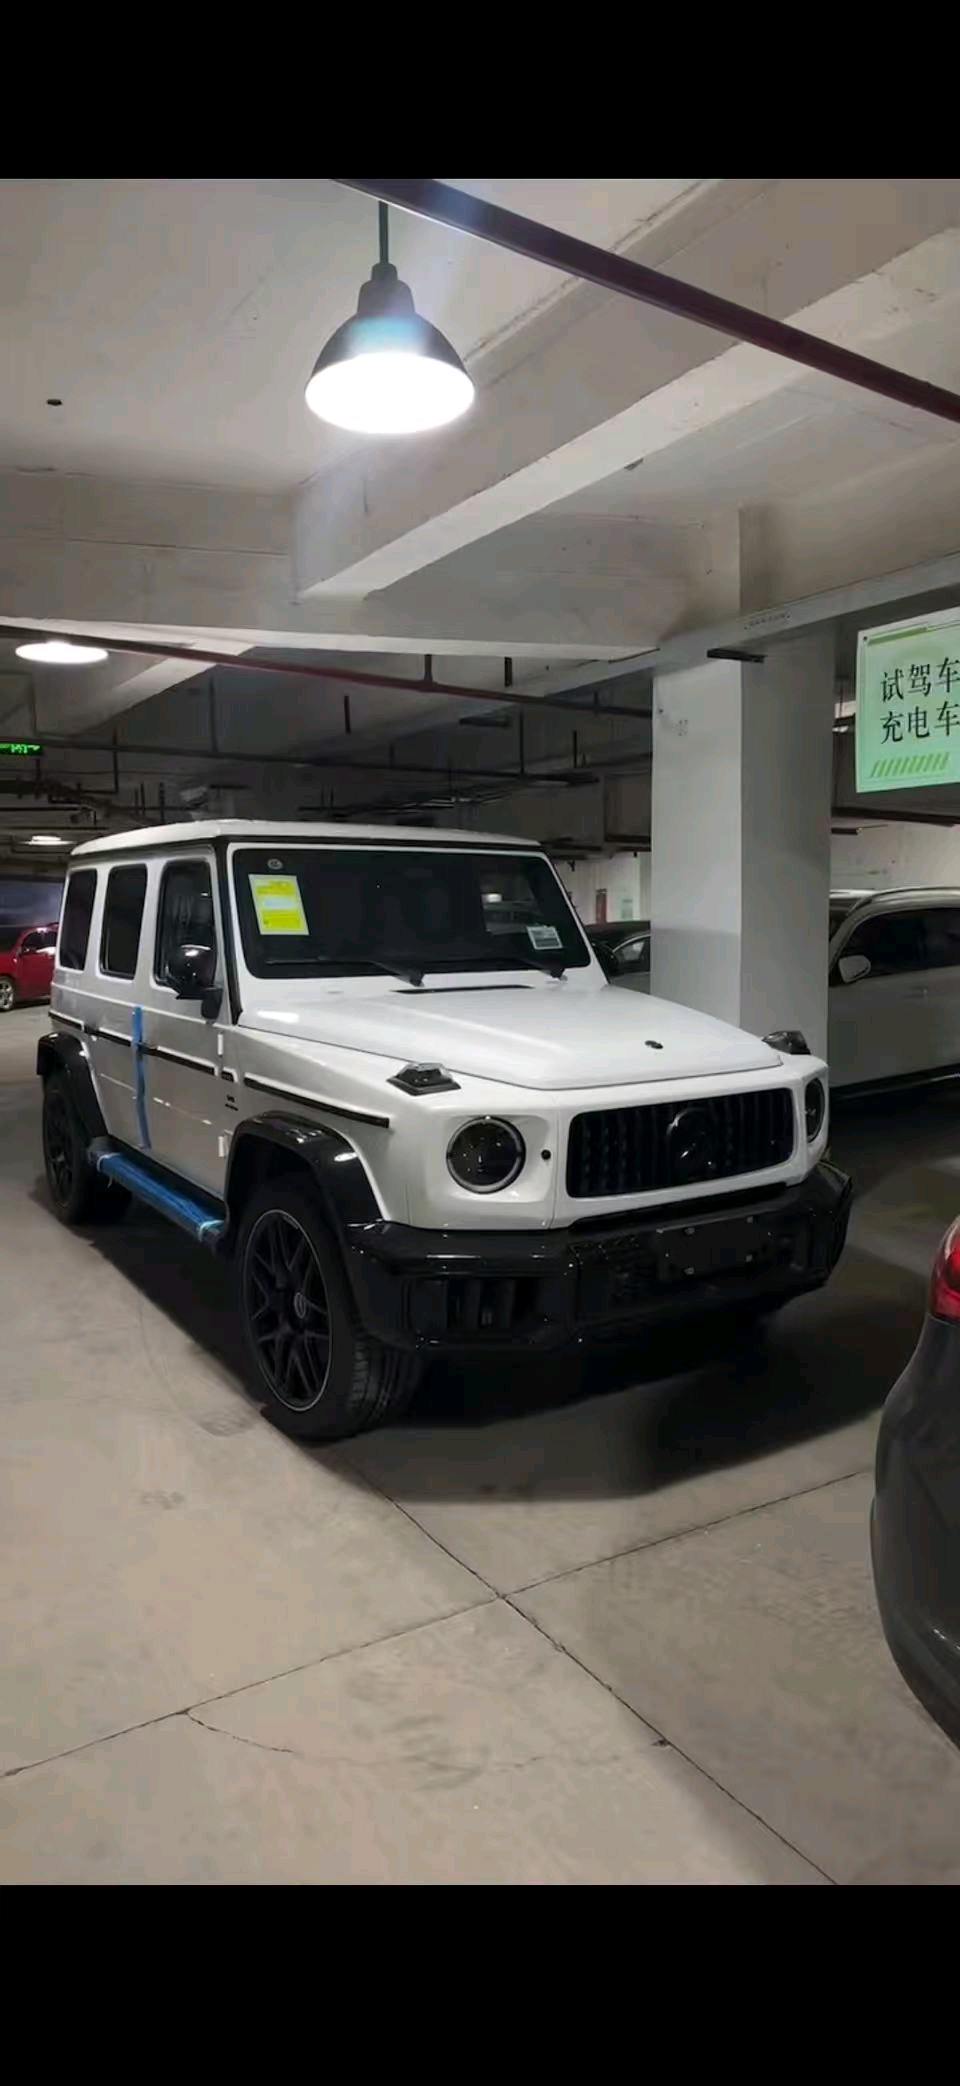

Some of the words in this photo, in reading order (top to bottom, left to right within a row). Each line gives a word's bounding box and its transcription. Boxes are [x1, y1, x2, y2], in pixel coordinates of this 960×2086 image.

[880, 657, 960, 703] 试驾车
[880, 701, 960, 745] 充电车
